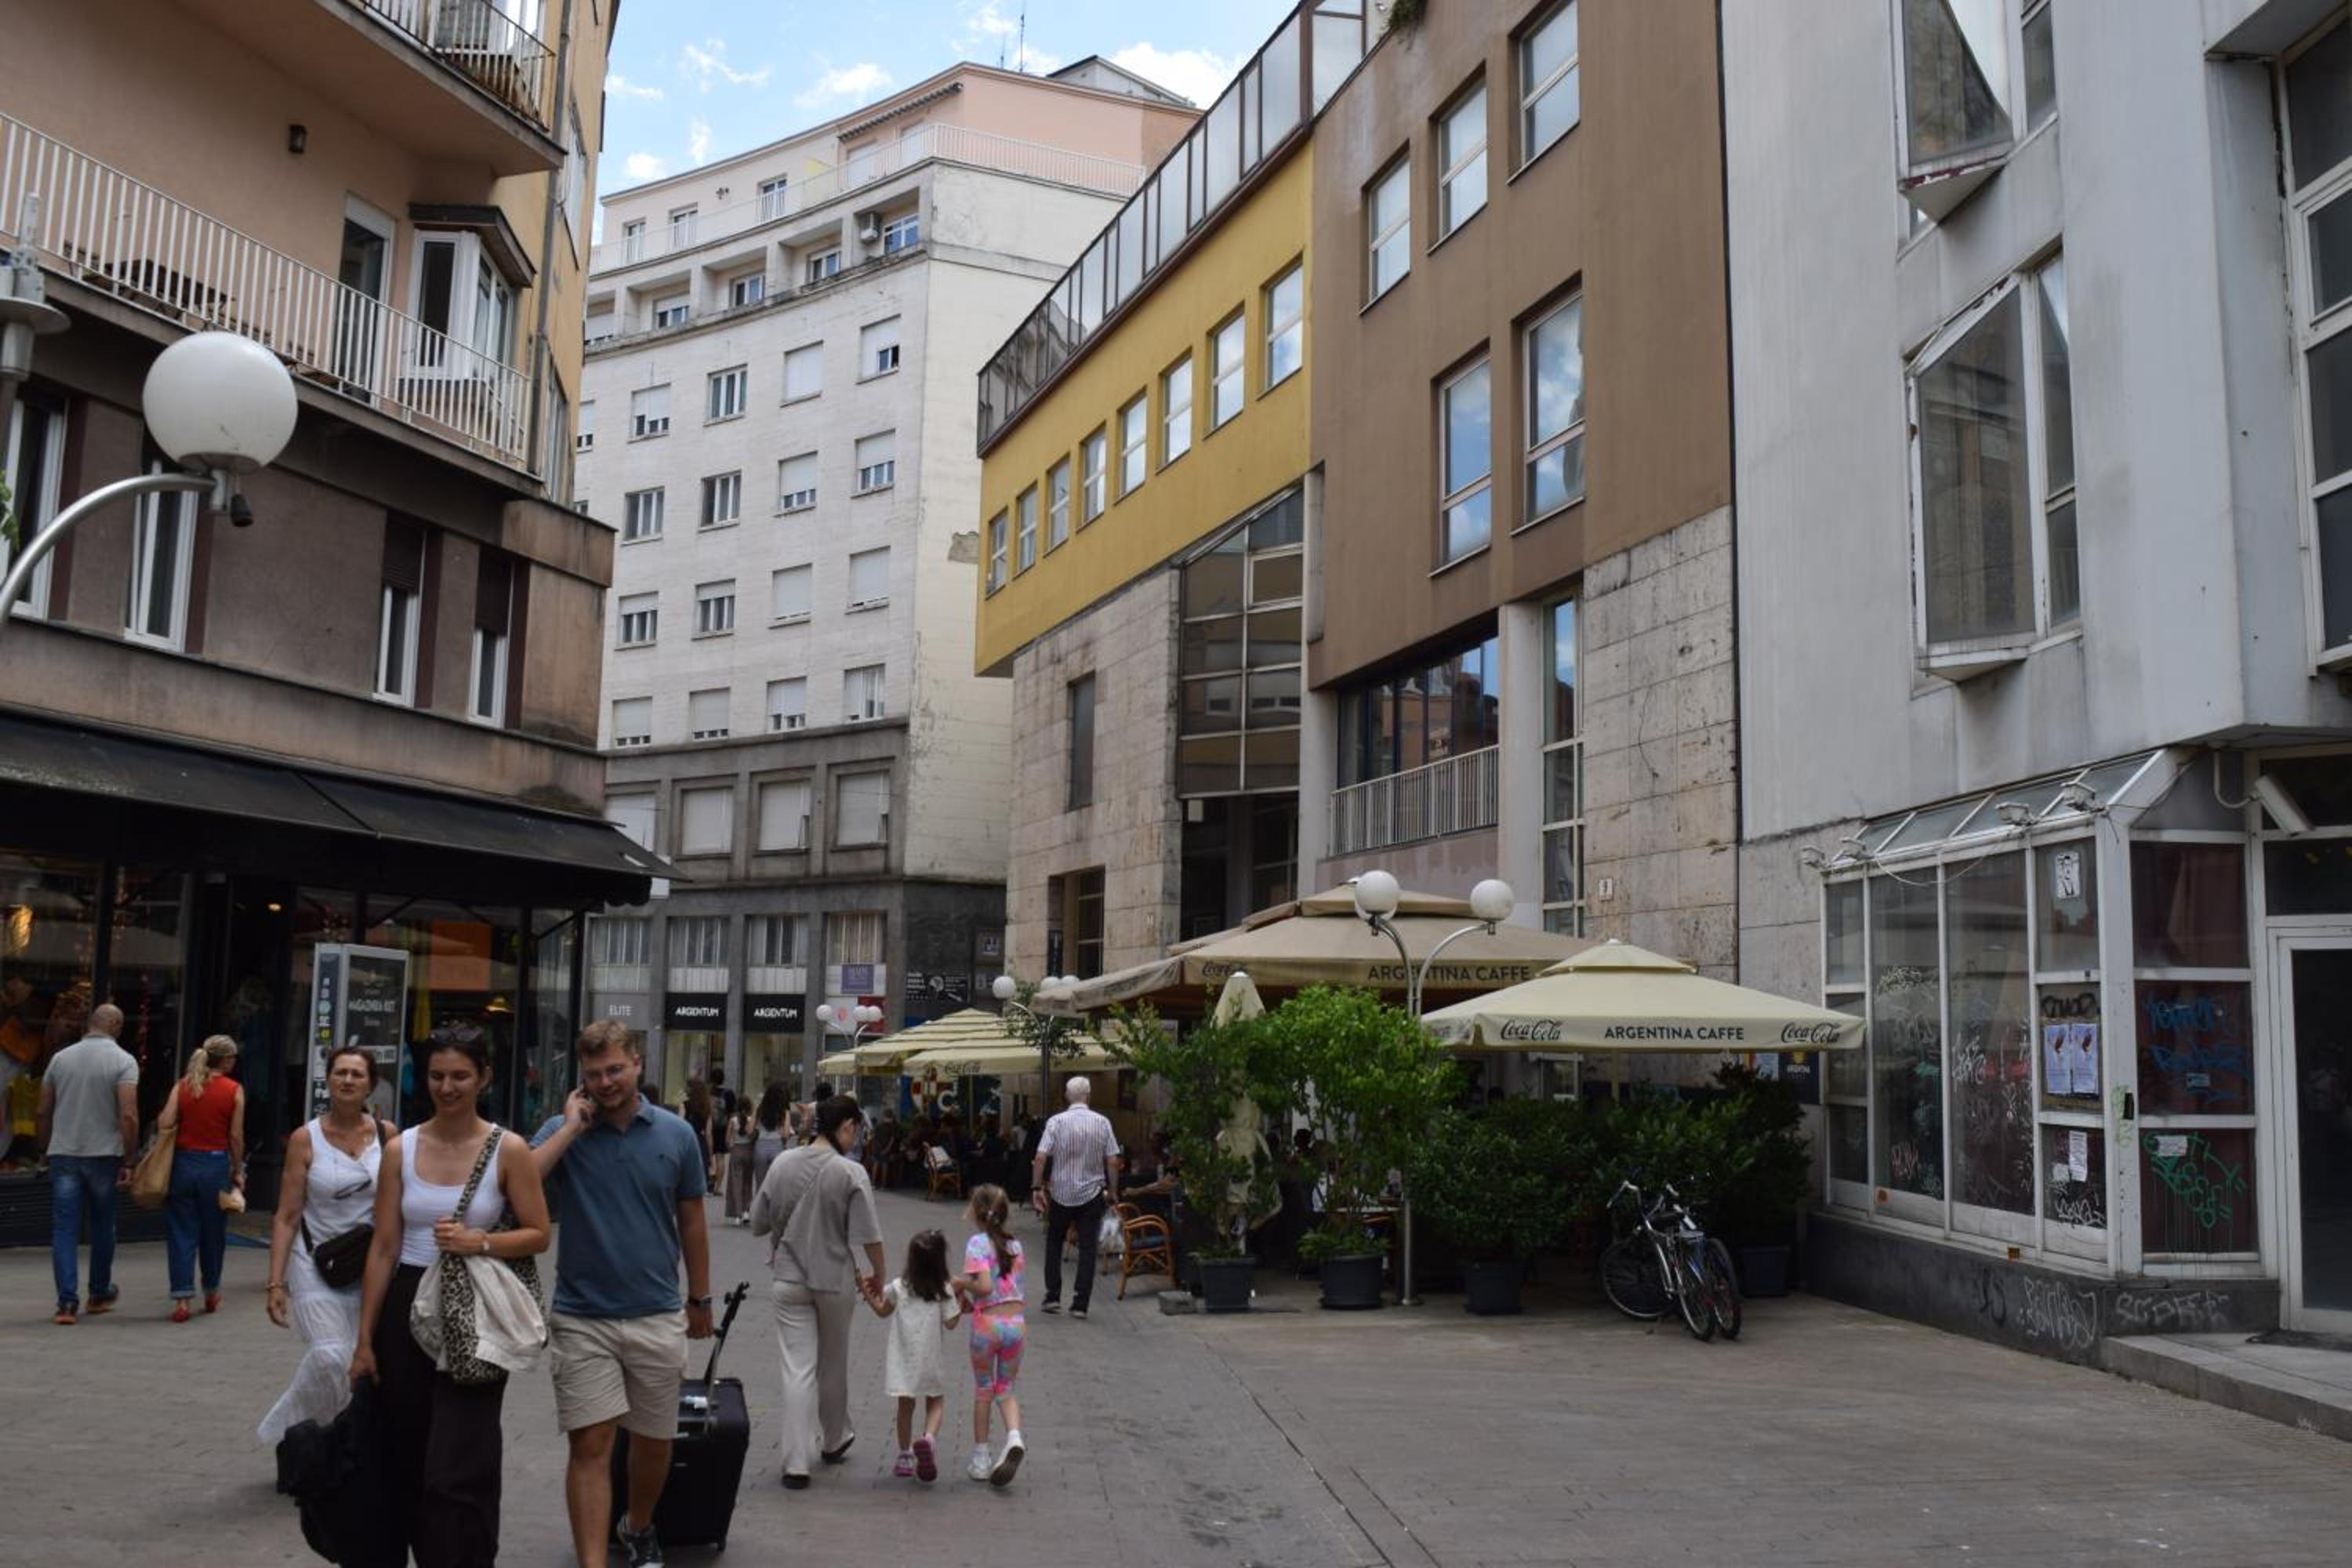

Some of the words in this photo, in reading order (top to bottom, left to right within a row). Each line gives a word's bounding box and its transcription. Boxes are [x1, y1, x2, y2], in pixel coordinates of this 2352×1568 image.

[1475, 965, 1530, 980] CAFFE
[609, 1004, 633, 1017] ELITE
[675, 1007, 720, 1018] ARGENTUM
[753, 1007, 798, 1018] ARGENTUM
[1604, 1026, 1693, 1040] ARGENTINA
[1697, 1027, 1744, 1041] CAFFE
